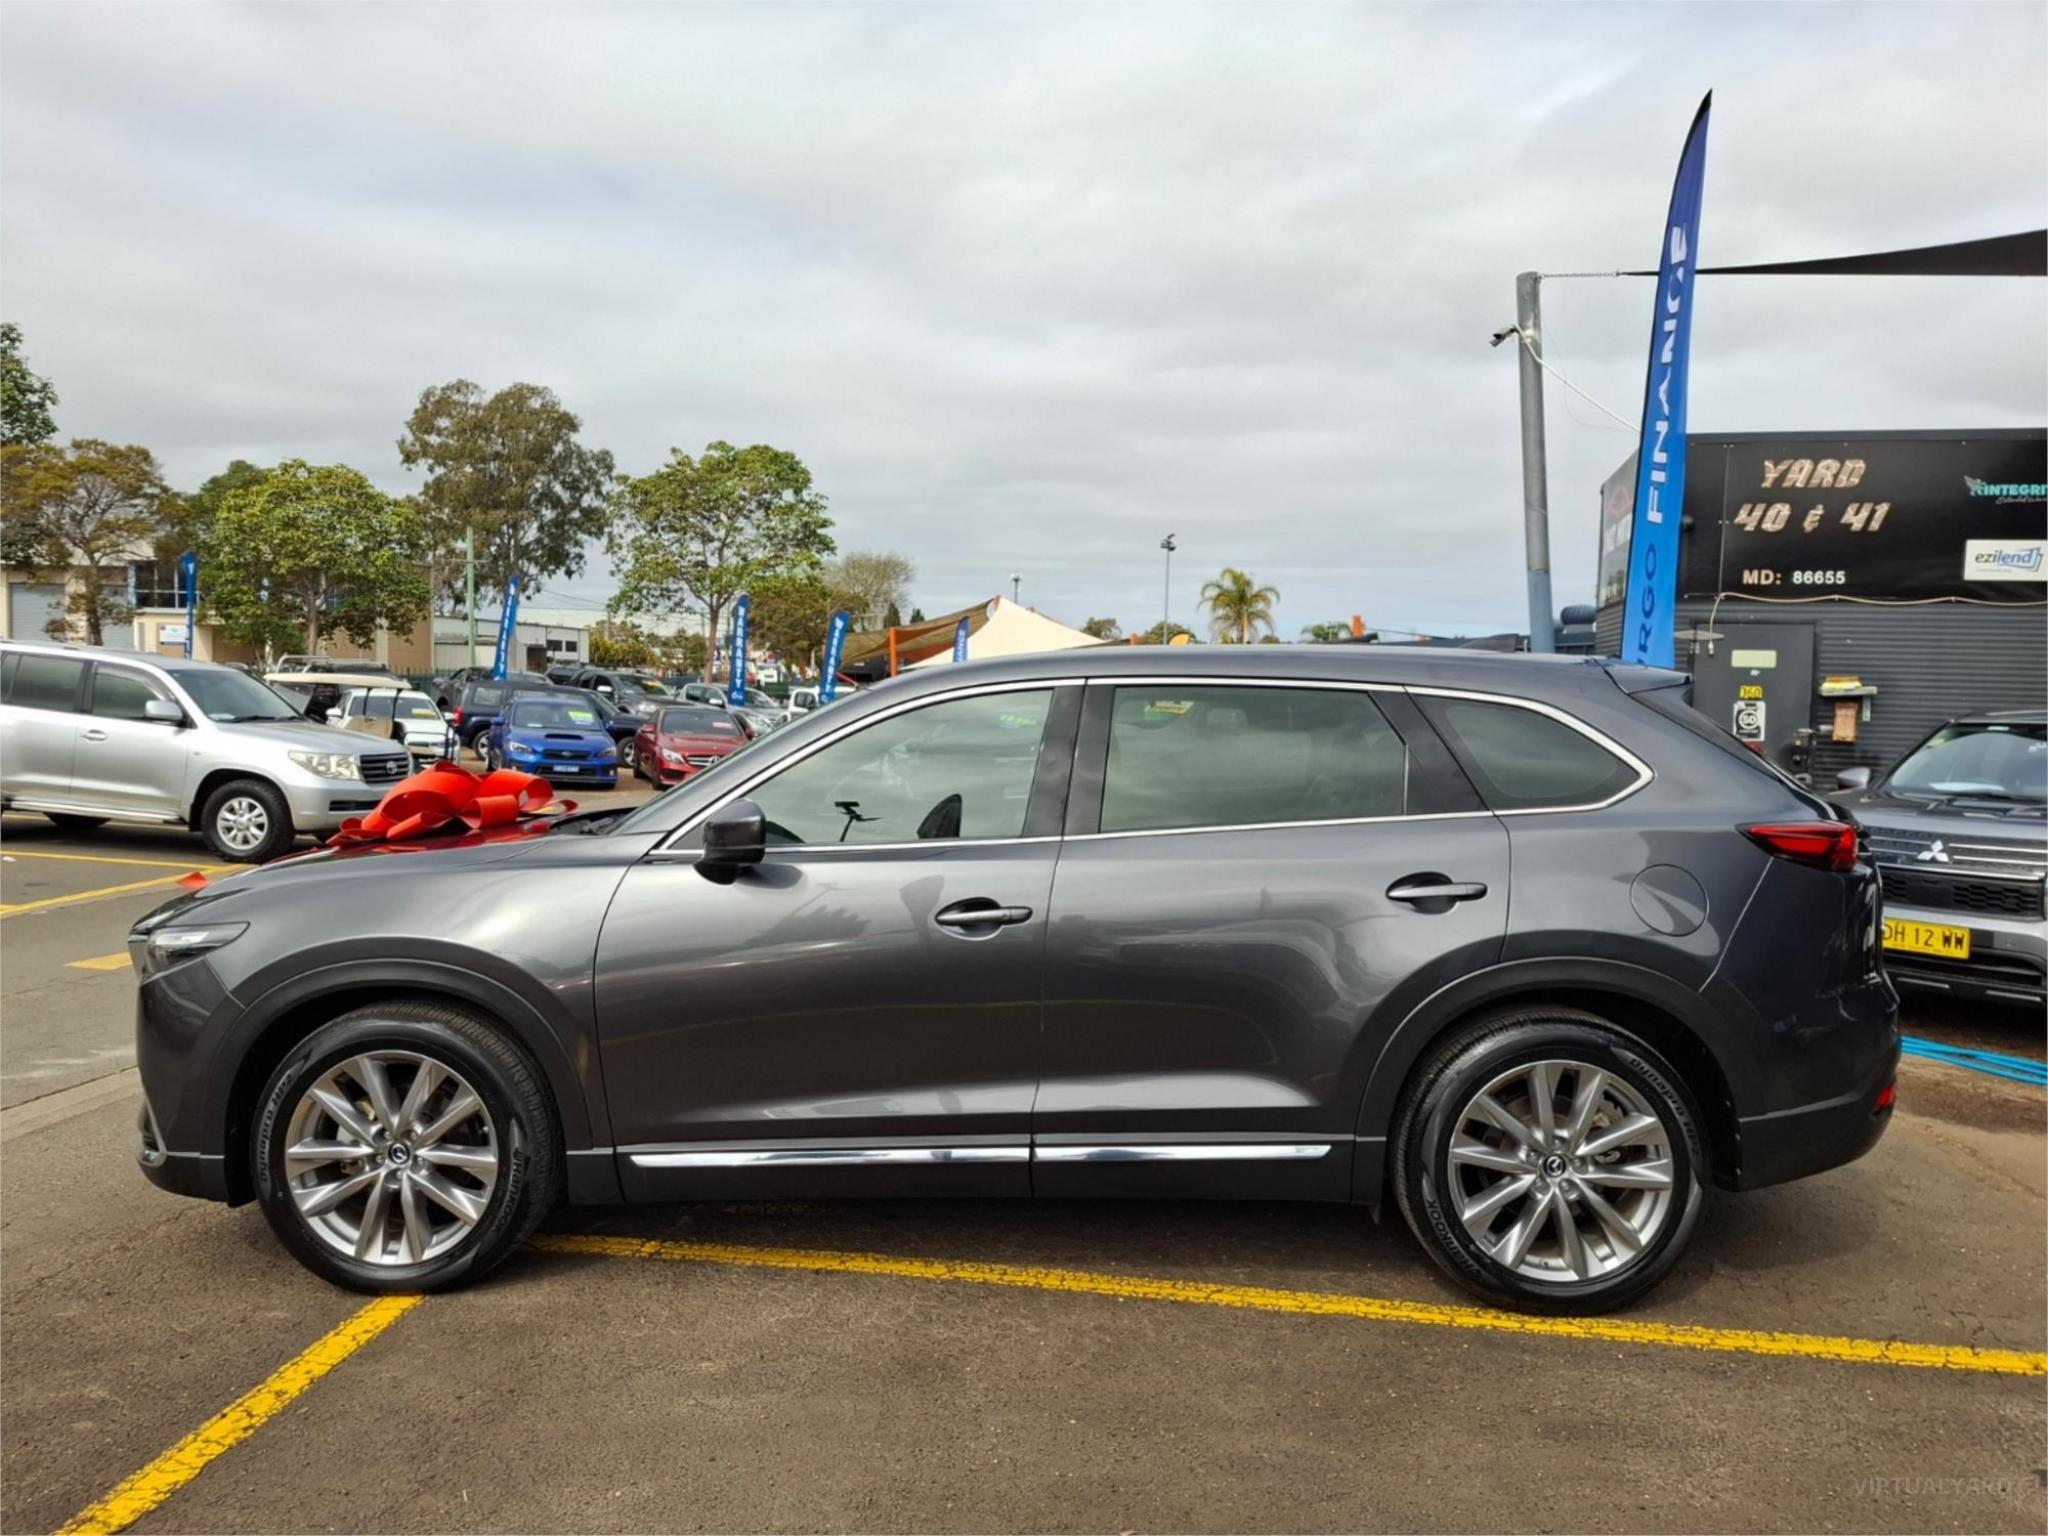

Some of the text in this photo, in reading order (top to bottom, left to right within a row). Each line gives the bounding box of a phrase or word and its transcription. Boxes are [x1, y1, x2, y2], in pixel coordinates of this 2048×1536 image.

[1647, 222, 1688, 524] FINANCE
[1761, 458, 1866, 488] YARD
[1734, 502, 1892, 533] 40 & 41
[1974, 549, 2034, 564] ezilend
[1742, 569, 1846, 585] MD: 86655
[735, 605, 746, 688] WARRANTY
[1914, 927, 1935, 947] 12
[1942, 930, 1966, 951] WW
